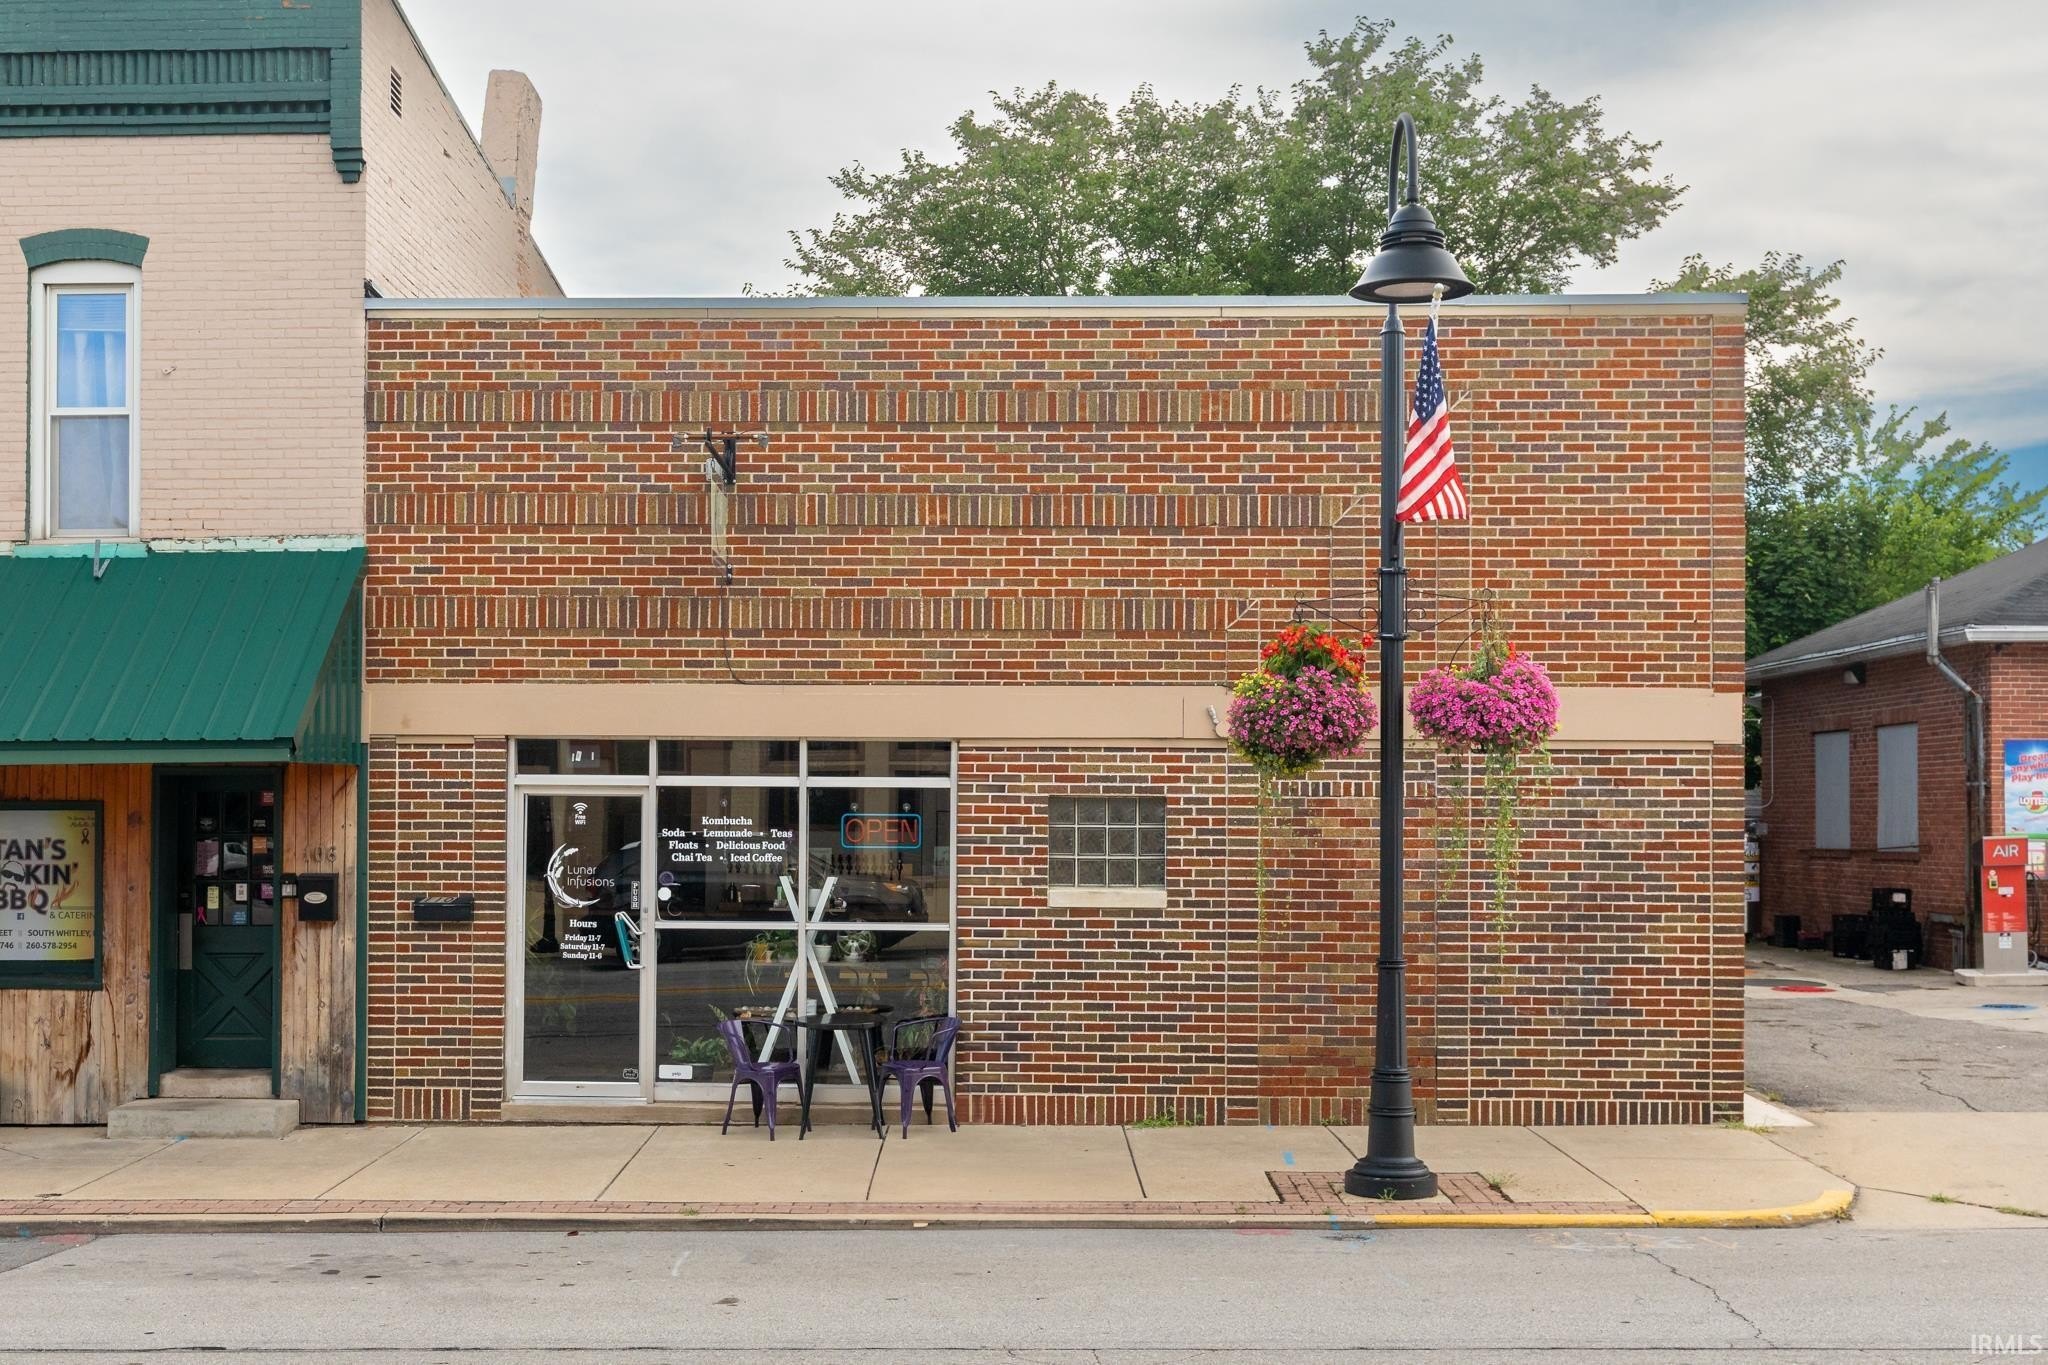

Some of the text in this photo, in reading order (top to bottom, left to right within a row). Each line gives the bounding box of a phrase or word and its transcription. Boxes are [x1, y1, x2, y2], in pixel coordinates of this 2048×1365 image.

[2011, 774, 2033, 782] Play
[701, 816, 753, 826] Kombucha
[661, 828, 793, 838] Soda Lemonade Teas
[845, 818, 918, 843] OPEN
[668, 840, 786, 850] Floats Delicious Food
[1992, 844, 2019, 857] AIR
[671, 853, 783, 862] Chai Tea Iced Coffee
[567, 865, 597, 875] Lunar
[567, 875, 615, 889] Infusions
[569, 919, 598, 928] Hours
[56, 930, 91, 938] WHITLEY,
[564, 934, 588, 942] Friday
[560, 943, 592, 952] Saturday
[562, 952, 589, 960] Sunday
